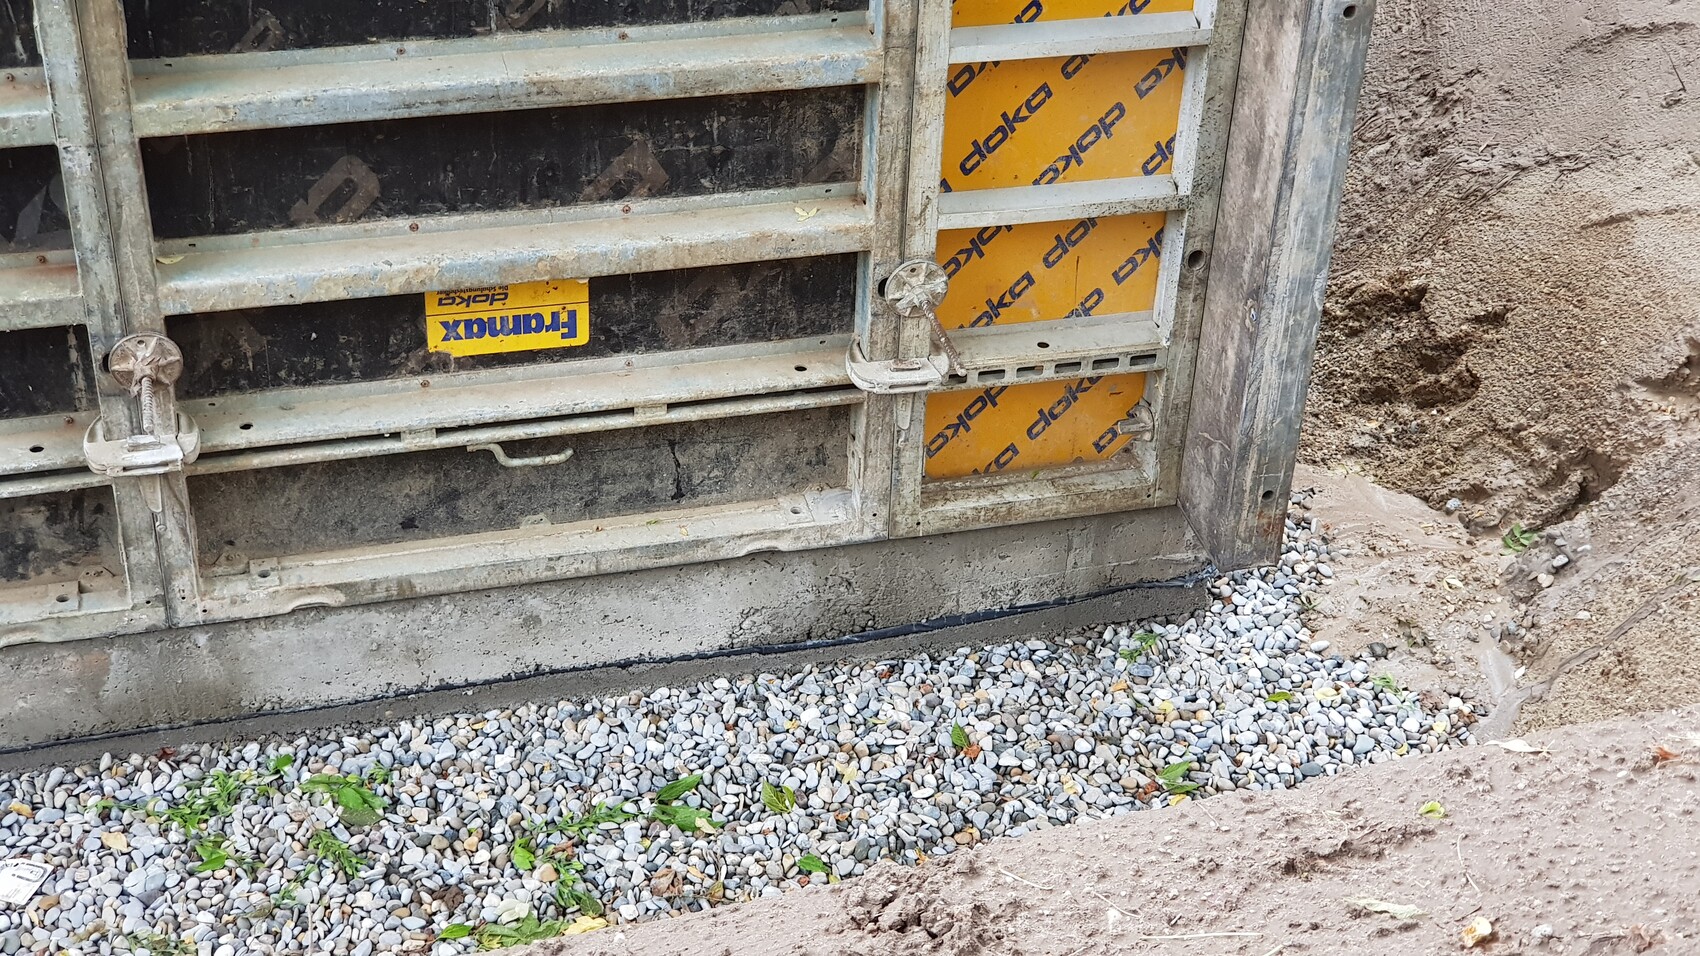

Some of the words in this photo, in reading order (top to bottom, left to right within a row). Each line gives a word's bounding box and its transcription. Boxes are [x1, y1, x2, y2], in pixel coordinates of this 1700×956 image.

[1134, 46, 1188, 100] ka
[959, 82, 1053, 177] doka
[942, 224, 1015, 281] oka
[1042, 217, 1099, 269] do
[437, 292, 509, 308] doka
[439, 310, 578, 342] Framax
[957, 271, 1036, 330] oka
